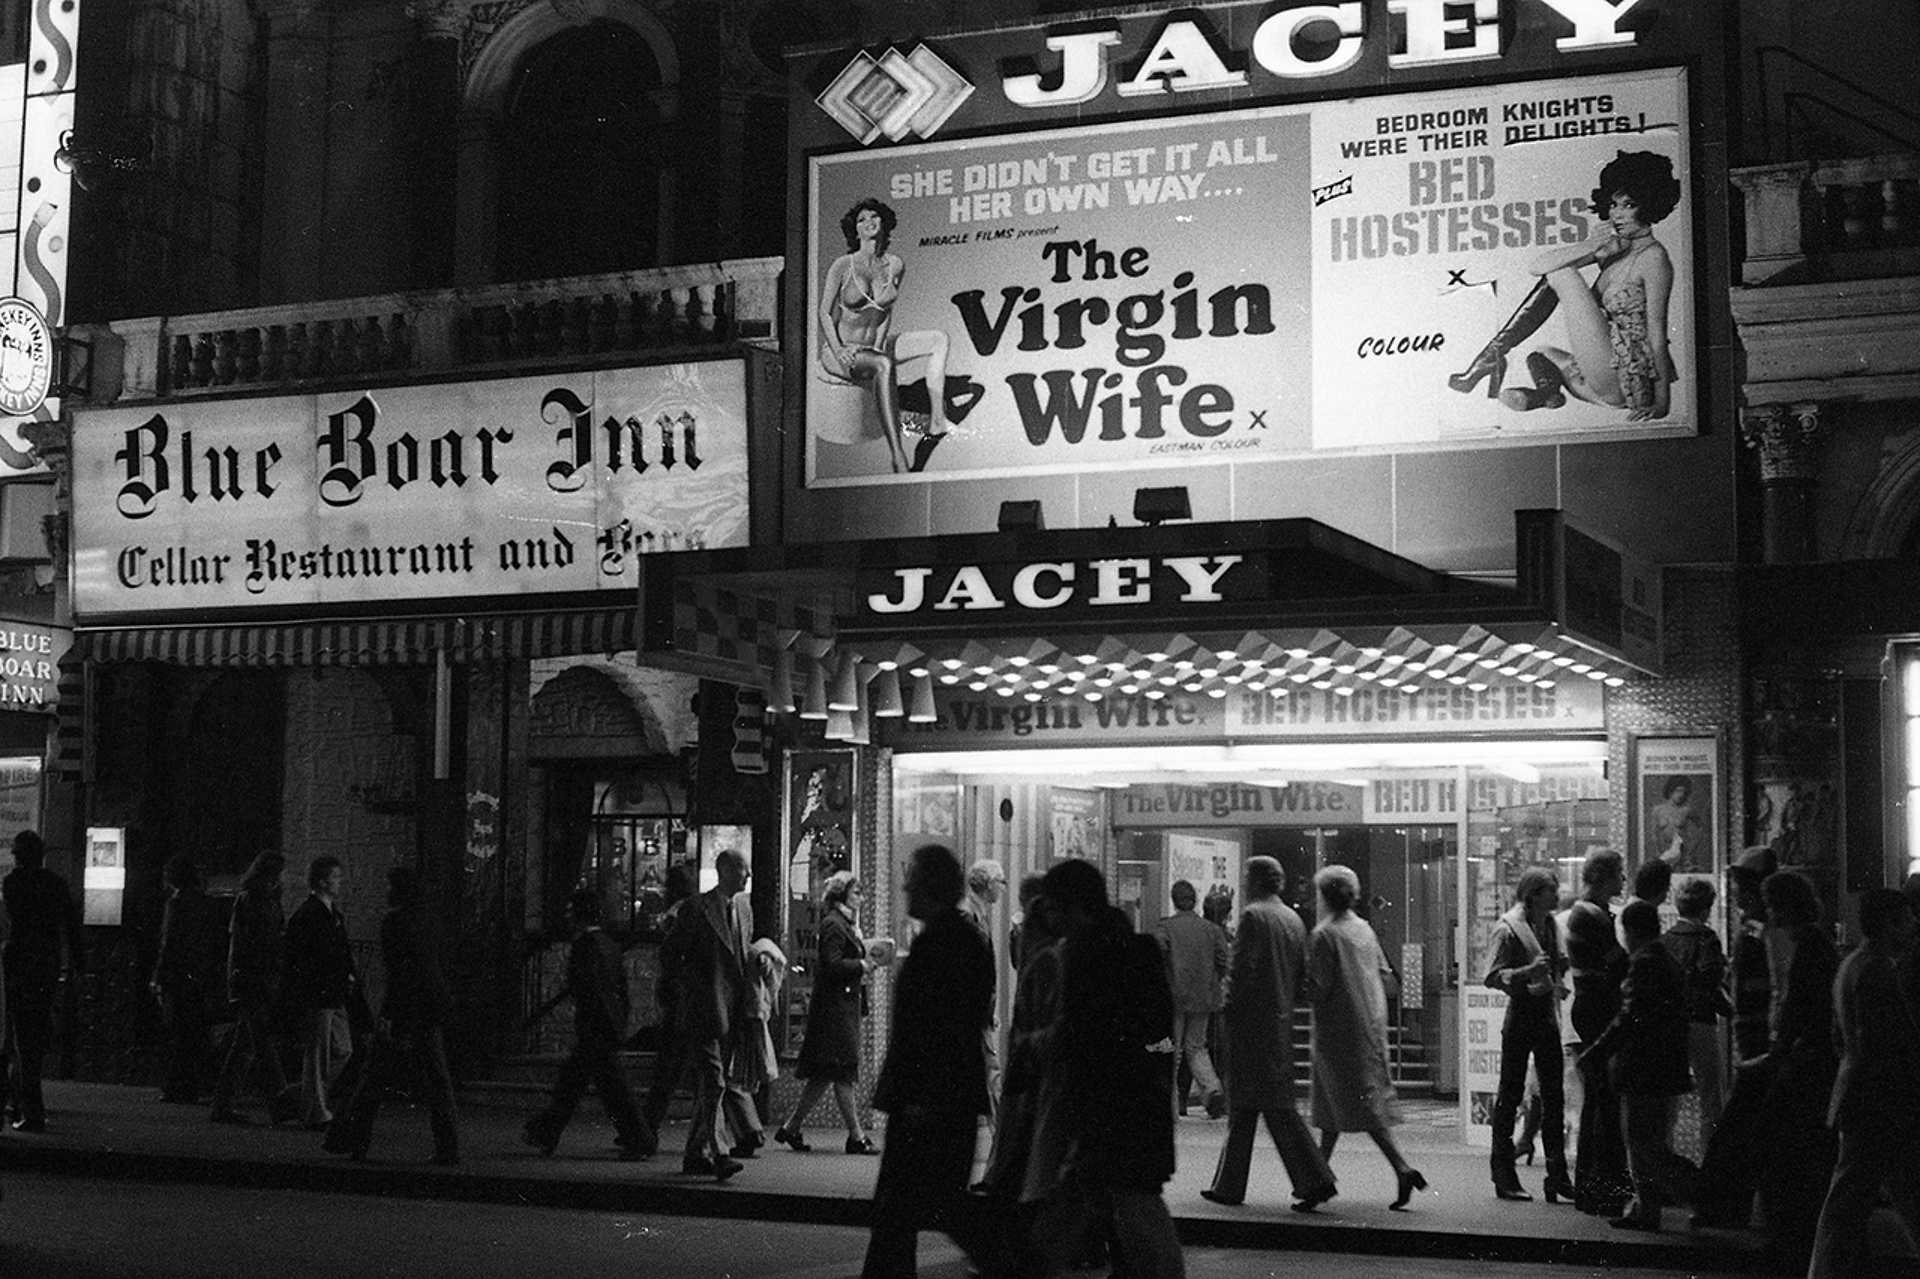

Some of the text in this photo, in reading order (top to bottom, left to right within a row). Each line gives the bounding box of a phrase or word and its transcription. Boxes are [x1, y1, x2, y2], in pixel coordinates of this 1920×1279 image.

[1003, 0, 1638, 107] JACEY
[1376, 95, 1614, 135] BEDROOM KNIGHTS
[889, 136, 1279, 200] SHE DIDN'T GET IT ALL
[1341, 138, 1408, 160] WERE
[1417, 129, 1489, 152] THEIR
[948, 191, 1019, 225] HER
[1024, 183, 1109, 215] OWN
[1408, 154, 1497, 207] BED
[918, 233, 969, 247] MIRACLE
[975, 228, 1015, 241] FILMS
[1330, 197, 1592, 262] HOSTESSES
[1042, 238, 1149, 283] The
[951, 271, 1277, 367] Virgin
[1357, 332, 1446, 359] COLOUR
[1005, 364, 1235, 447] Wife
[114, 387, 703, 520] Blue Boar Inn
[117, 544, 231, 589] Cellar
[244, 536, 475, 594] Restaurant
[499, 526, 575, 573] and
[867, 555, 1243, 614] JACEY
[1, 682, 44, 705] INN
